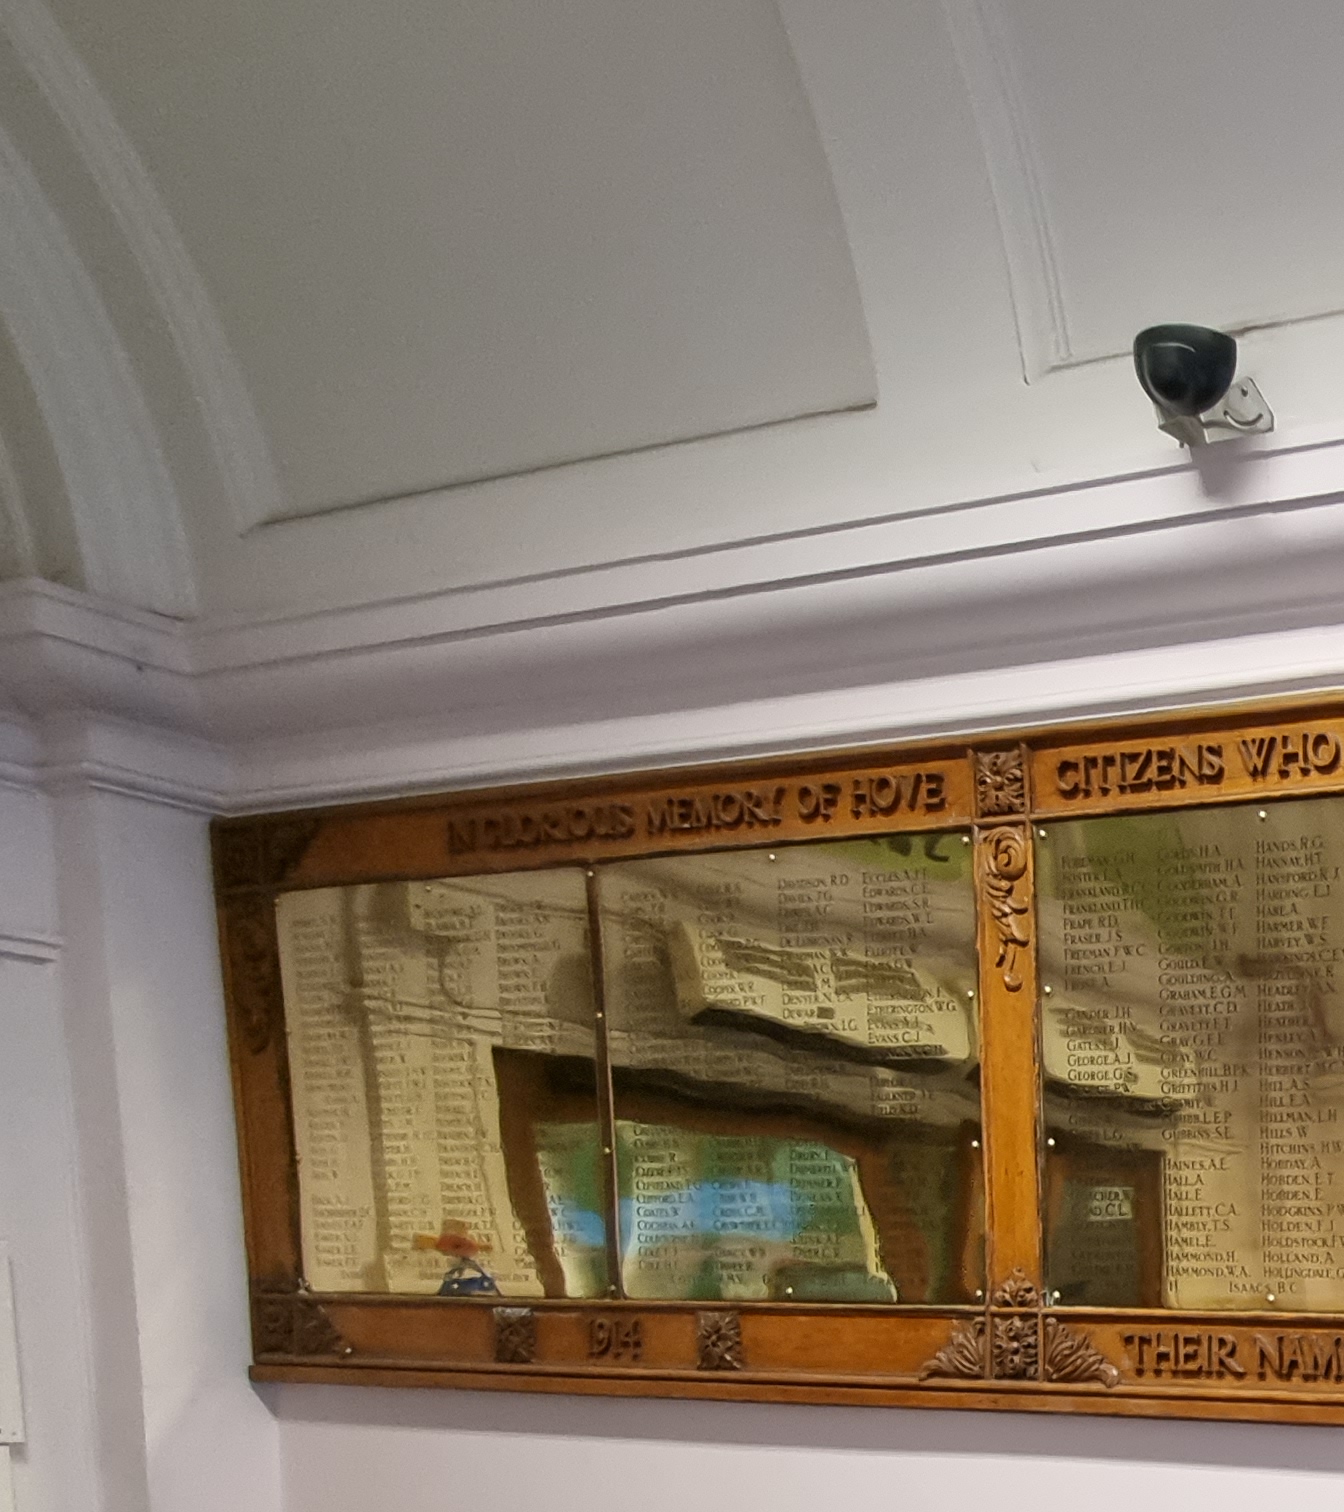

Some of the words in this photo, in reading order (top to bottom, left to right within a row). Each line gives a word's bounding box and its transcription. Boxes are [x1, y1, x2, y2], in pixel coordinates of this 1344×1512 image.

[485, 801, 635, 849] GLORIOUS
[647, 787, 787, 836] MEMORY
[799, 784, 842, 825] OF
[850, 772, 948, 819] HOVE
[1057, 742, 1225, 799] CITIZENS
[1241, 731, 1341, 781] WHO
[587, 1319, 642, 1361] 1914
[1124, 1332, 1247, 1380] THEIR
